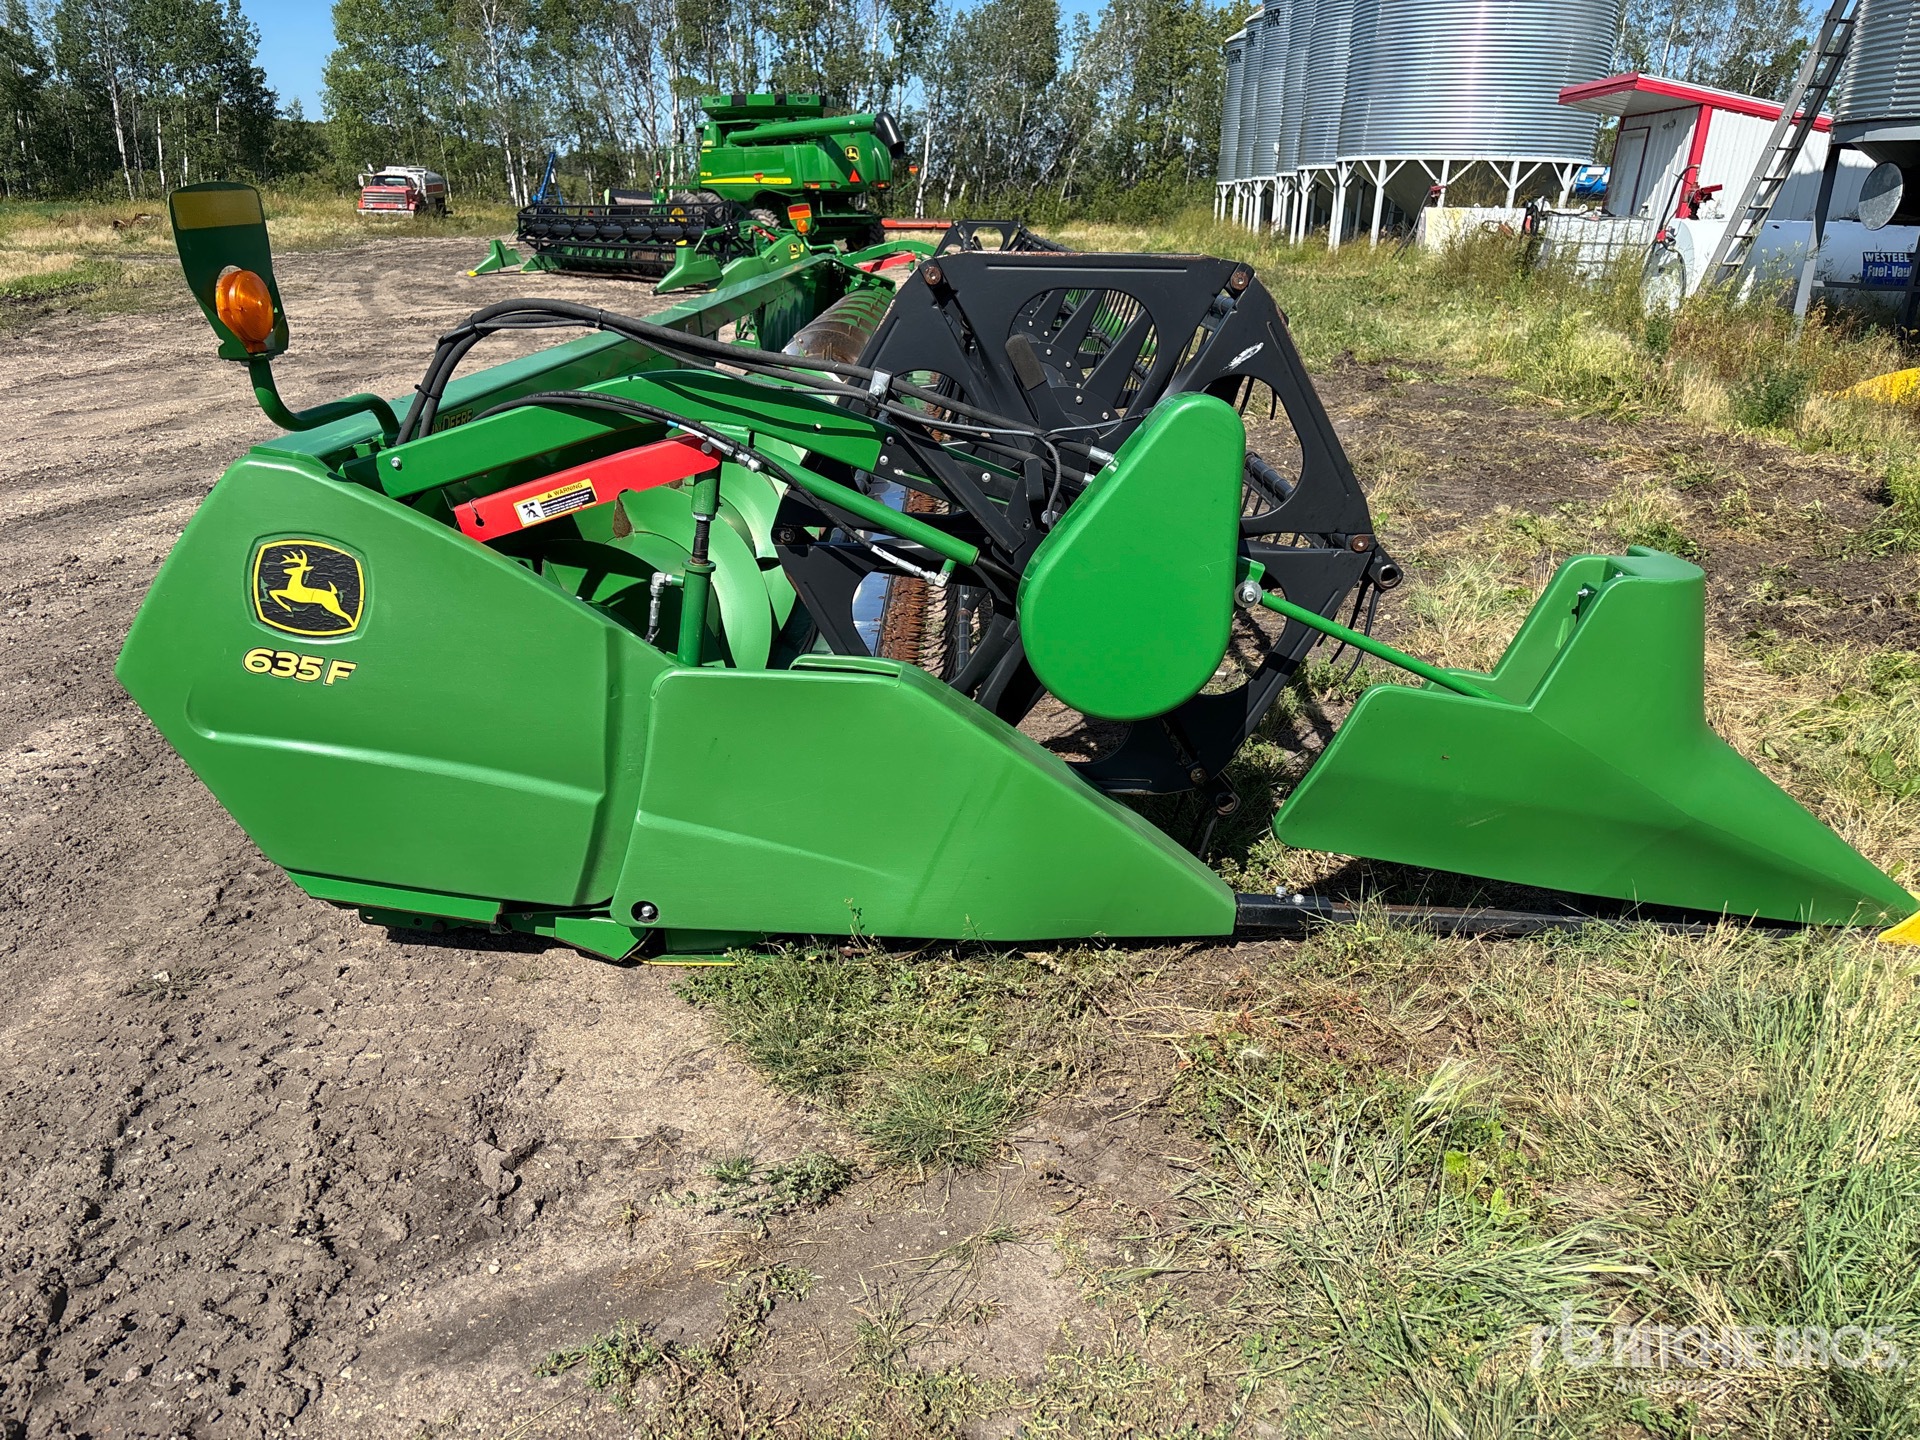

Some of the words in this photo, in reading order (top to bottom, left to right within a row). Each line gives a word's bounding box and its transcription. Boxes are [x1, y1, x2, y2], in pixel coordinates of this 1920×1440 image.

[1864, 252, 1910, 263] WESTEEL
[1867, 265, 1913, 278] Fuel-Vaul
[443, 408, 473, 431] DEERE
[553, 482, 583, 496] WARNING
